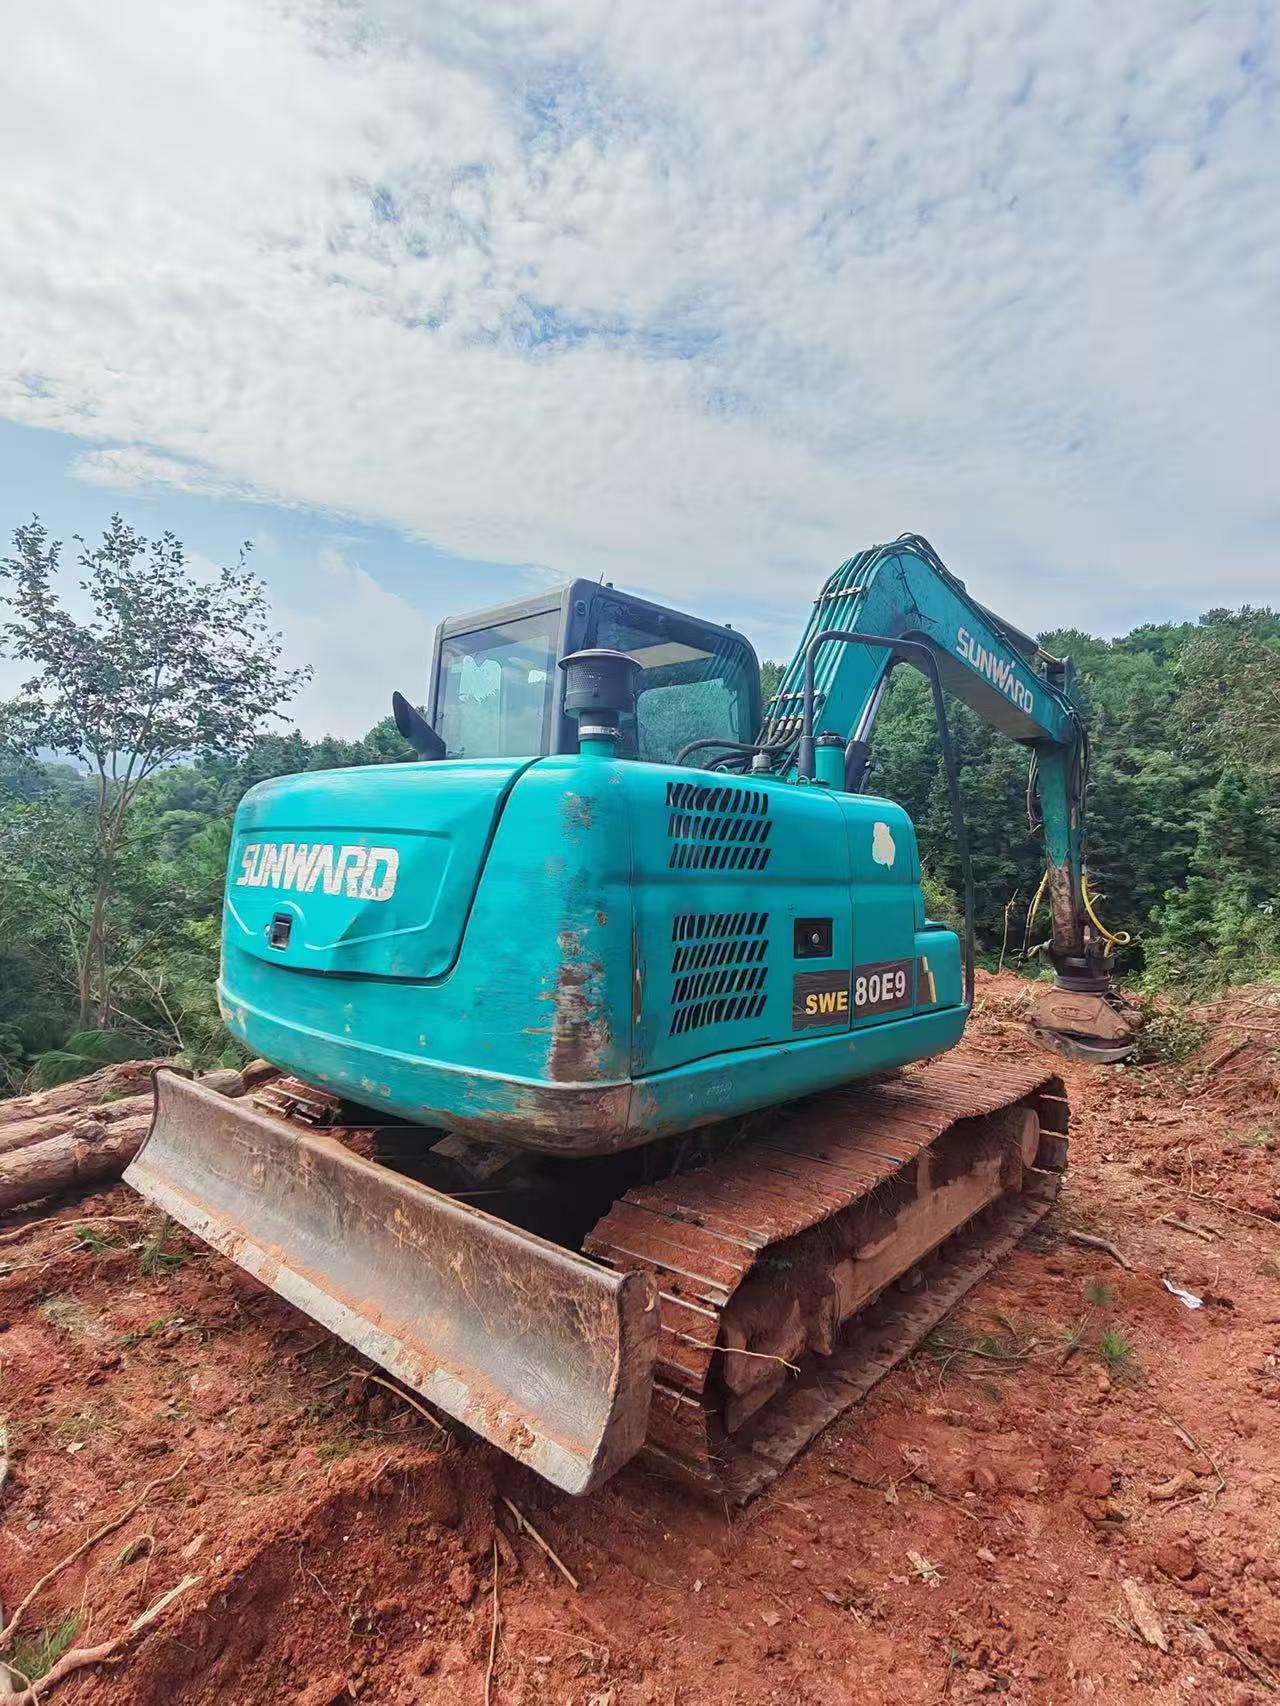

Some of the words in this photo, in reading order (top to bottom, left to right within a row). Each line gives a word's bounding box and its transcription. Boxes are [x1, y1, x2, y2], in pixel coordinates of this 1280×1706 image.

[956, 627, 1034, 714] SUNWARD
[236, 843, 399, 901] SUNWARD
[805, 991, 848, 1015] SWE
[855, 970, 906, 1006] 80E9
